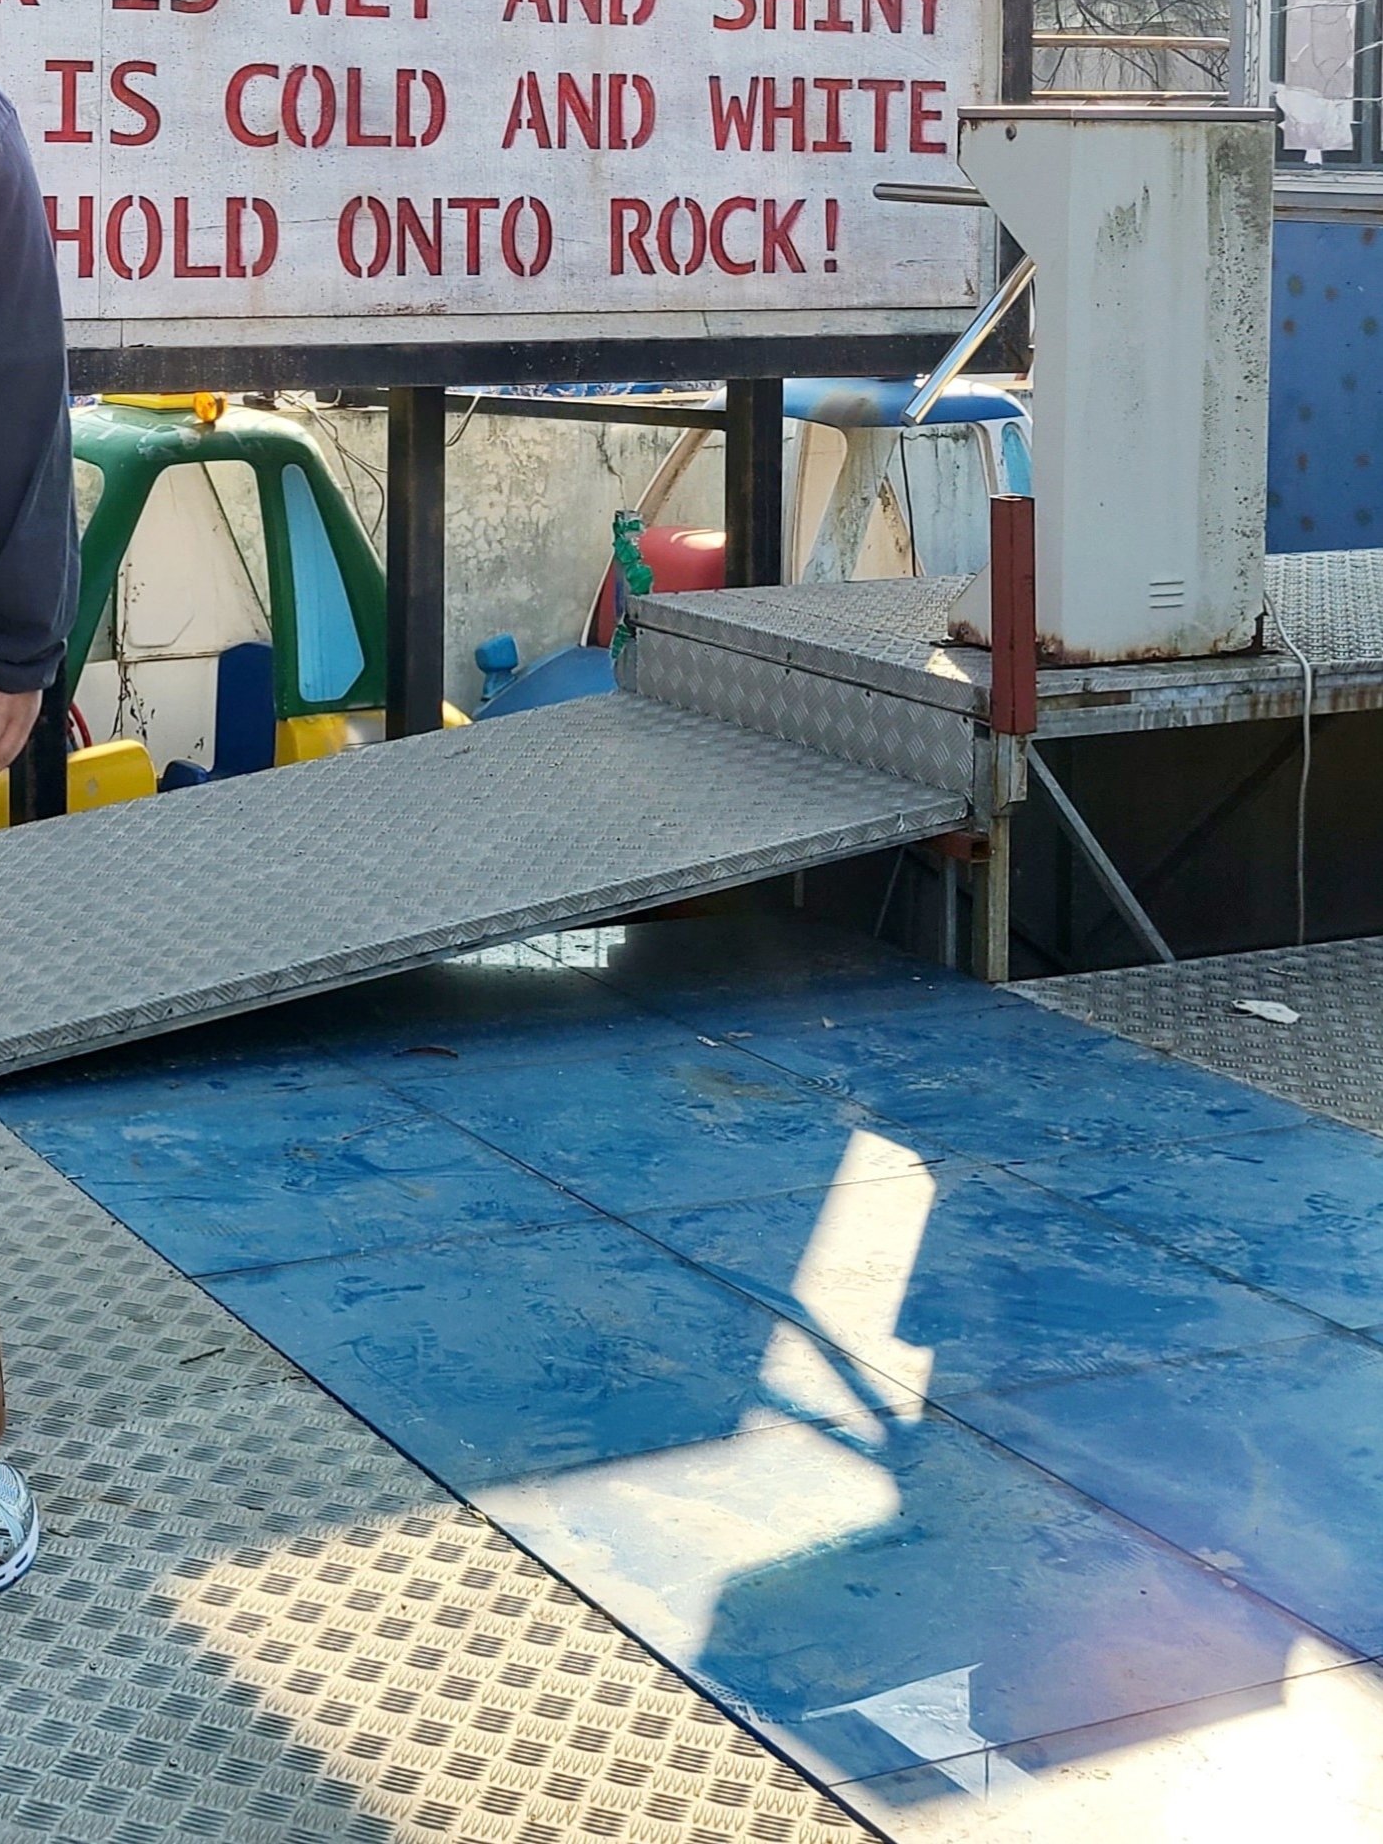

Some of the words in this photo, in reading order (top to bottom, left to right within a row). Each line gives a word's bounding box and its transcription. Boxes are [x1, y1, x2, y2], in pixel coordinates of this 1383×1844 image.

[43, 59, 161, 147] IS
[224, 62, 447, 150] COLD
[502, 70, 657, 151] AND
[709, 76, 947, 155] WHITE
[43, 194, 280, 281] HOLD
[335, 194, 553, 278] ONTO
[608, 195, 841, 277] ROCK!
